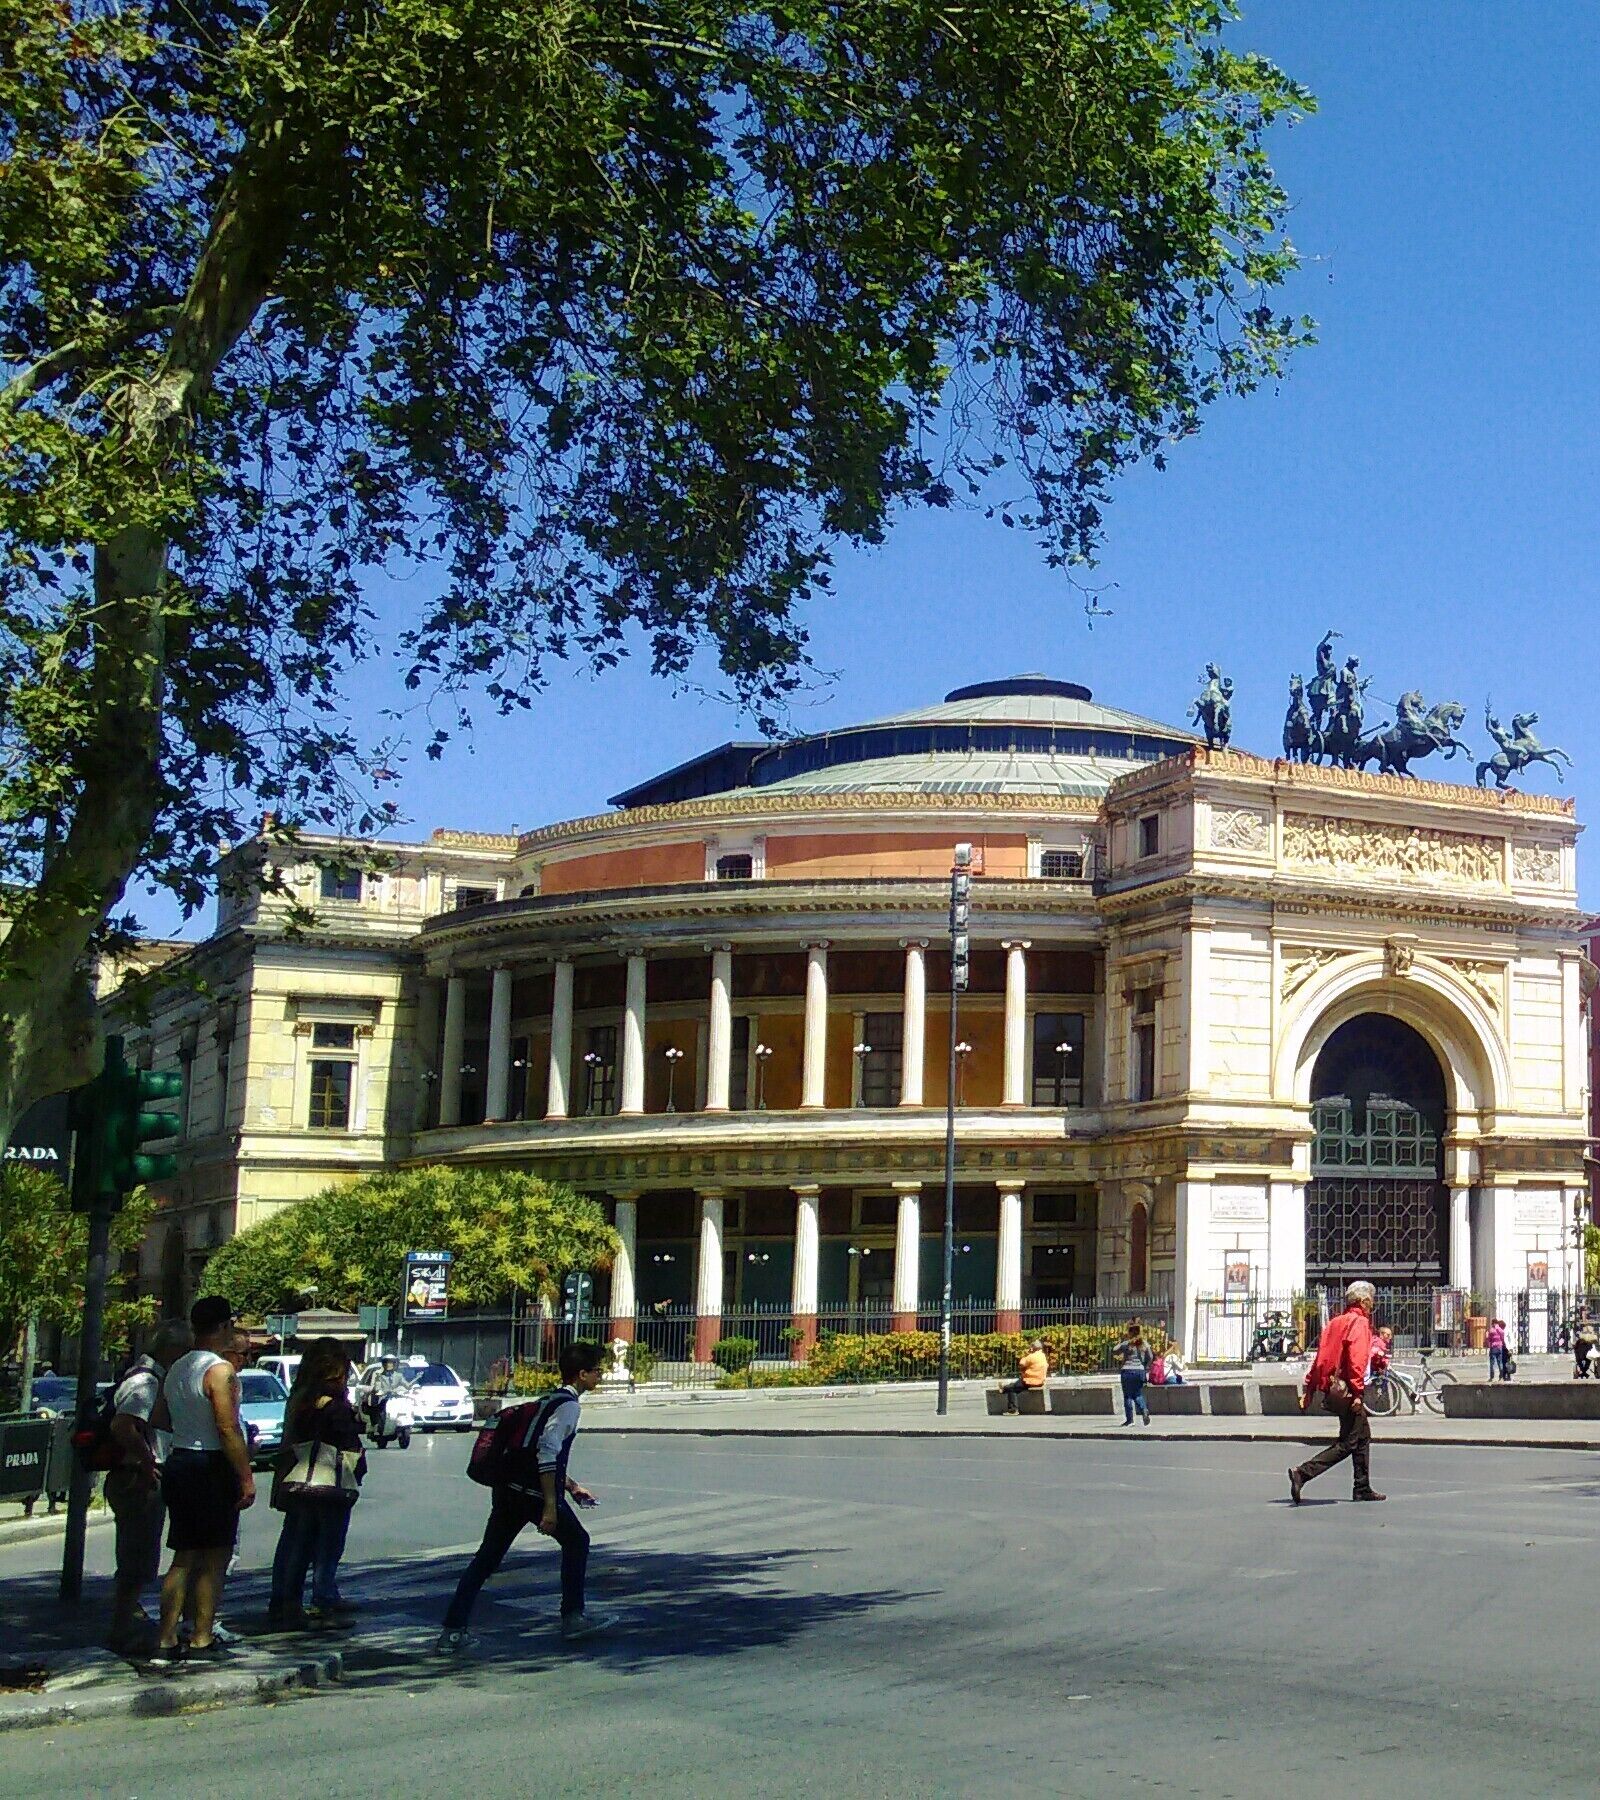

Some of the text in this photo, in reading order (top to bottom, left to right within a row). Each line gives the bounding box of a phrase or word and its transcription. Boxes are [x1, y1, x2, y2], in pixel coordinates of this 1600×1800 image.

[3, 1146, 59, 1160] RADA
[415, 1252, 443, 1261] TAXI
[5, 1452, 39, 1468] PRADA
